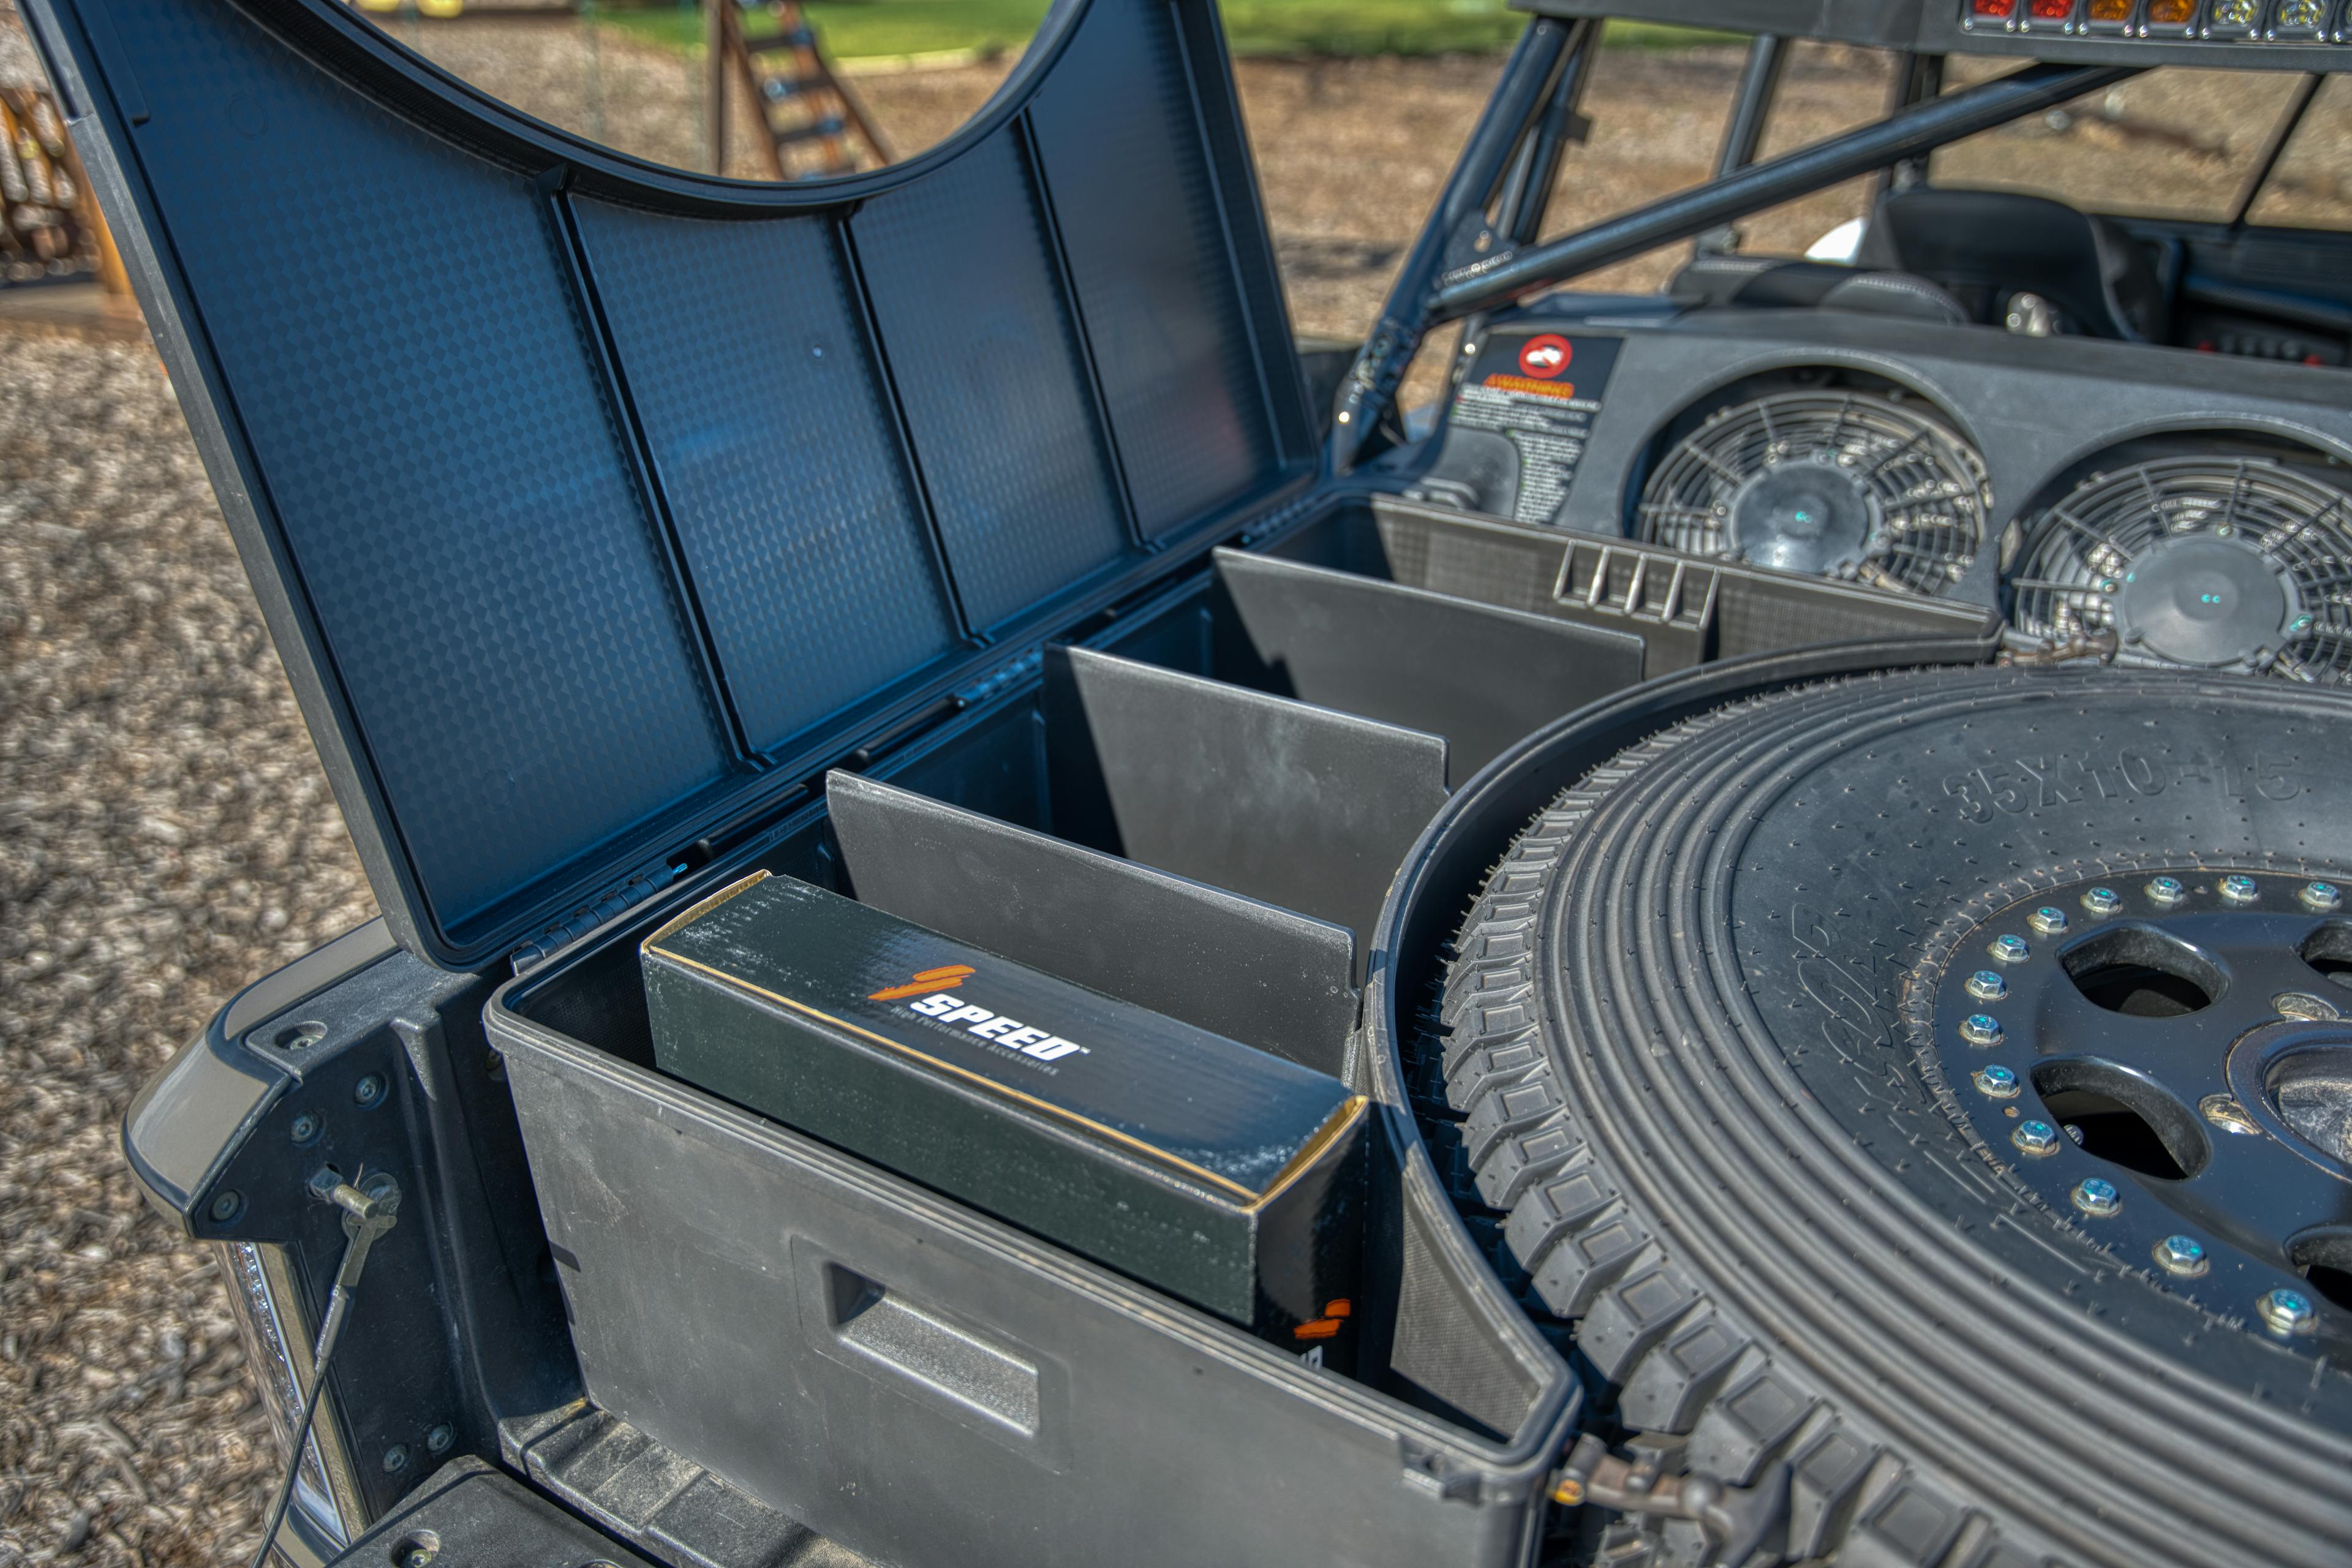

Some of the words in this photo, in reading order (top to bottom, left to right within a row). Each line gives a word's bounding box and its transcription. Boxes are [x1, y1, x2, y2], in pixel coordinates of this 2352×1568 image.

[890, 1005, 917, 1020] High
[918, 1015, 987, 1047] Performance
[987, 1044, 1060, 1076] Accessories
[909, 993, 1081, 1062] SPEED
